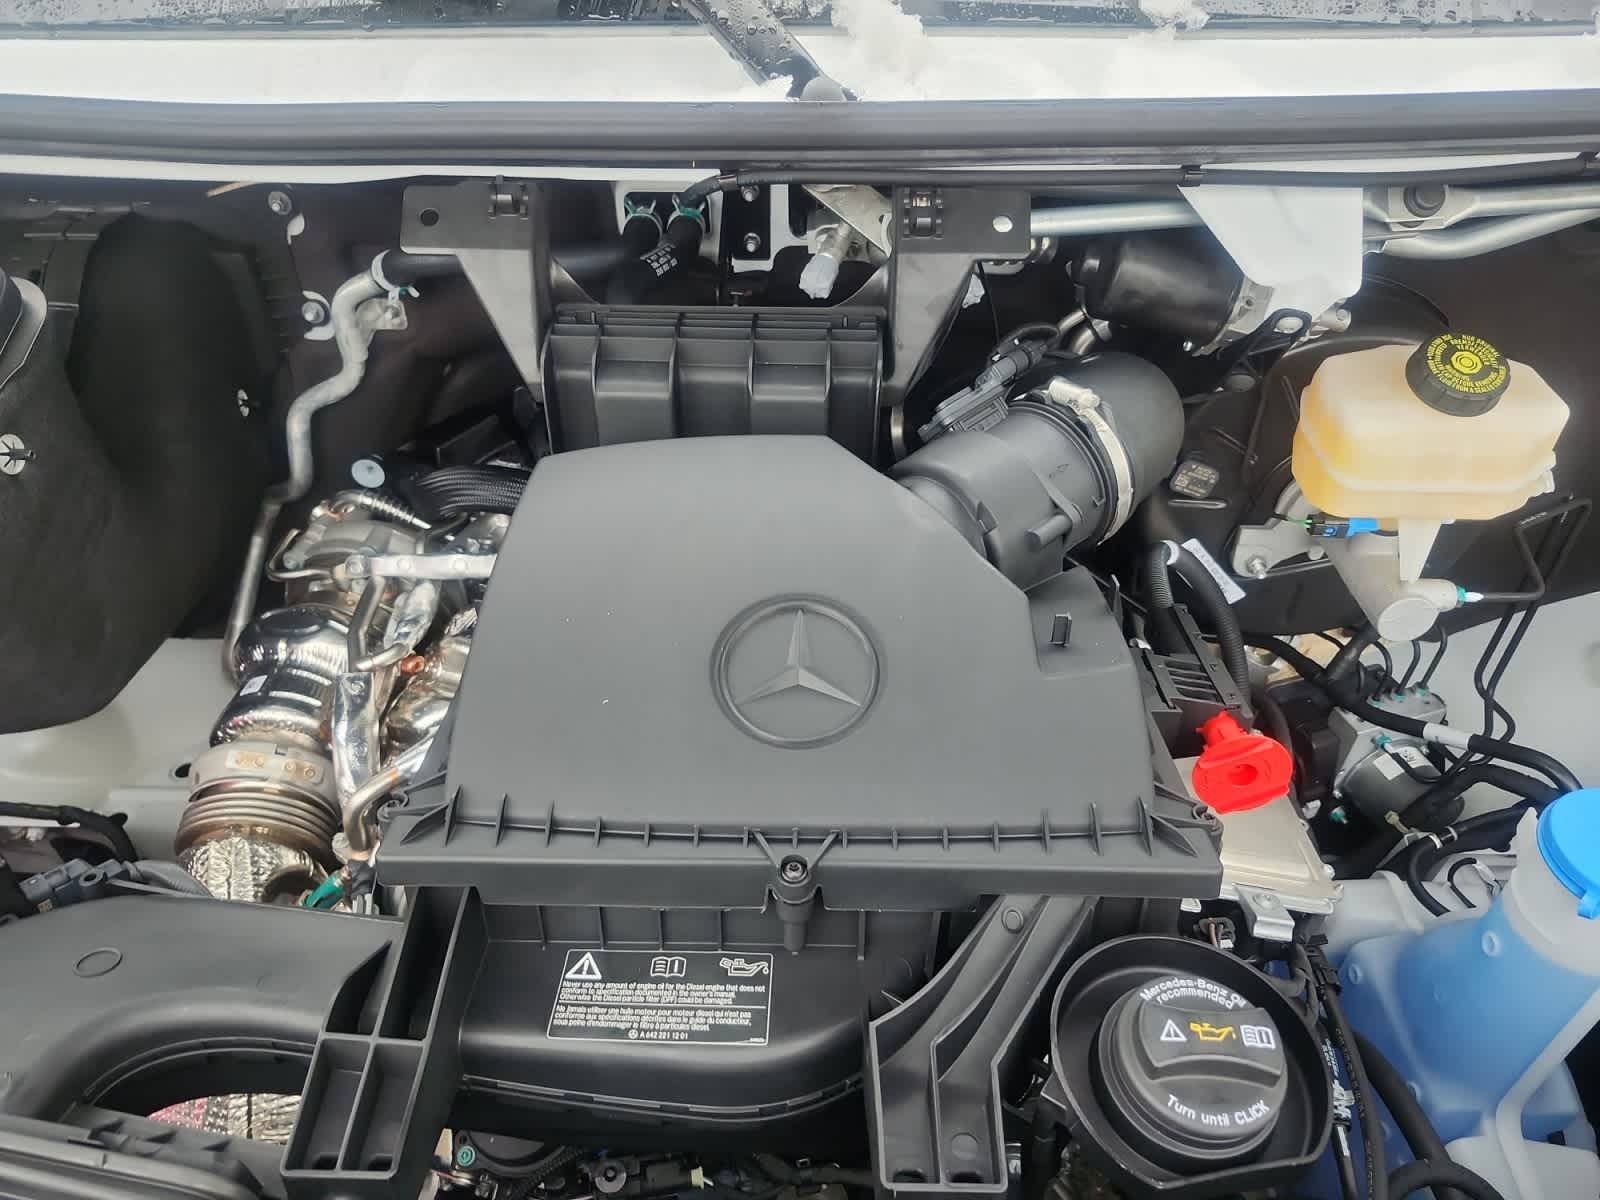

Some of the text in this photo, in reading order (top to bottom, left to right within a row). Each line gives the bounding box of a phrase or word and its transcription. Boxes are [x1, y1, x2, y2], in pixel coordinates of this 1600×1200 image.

[594, 982, 605, 990] any
[637, 983, 656, 991] engine
[1140, 977, 1248, 1008] Mercedes-Benz Oil
[1156, 987, 1235, 1010] recommended
[1167, 1094, 1270, 1127] Turn until CLICK
